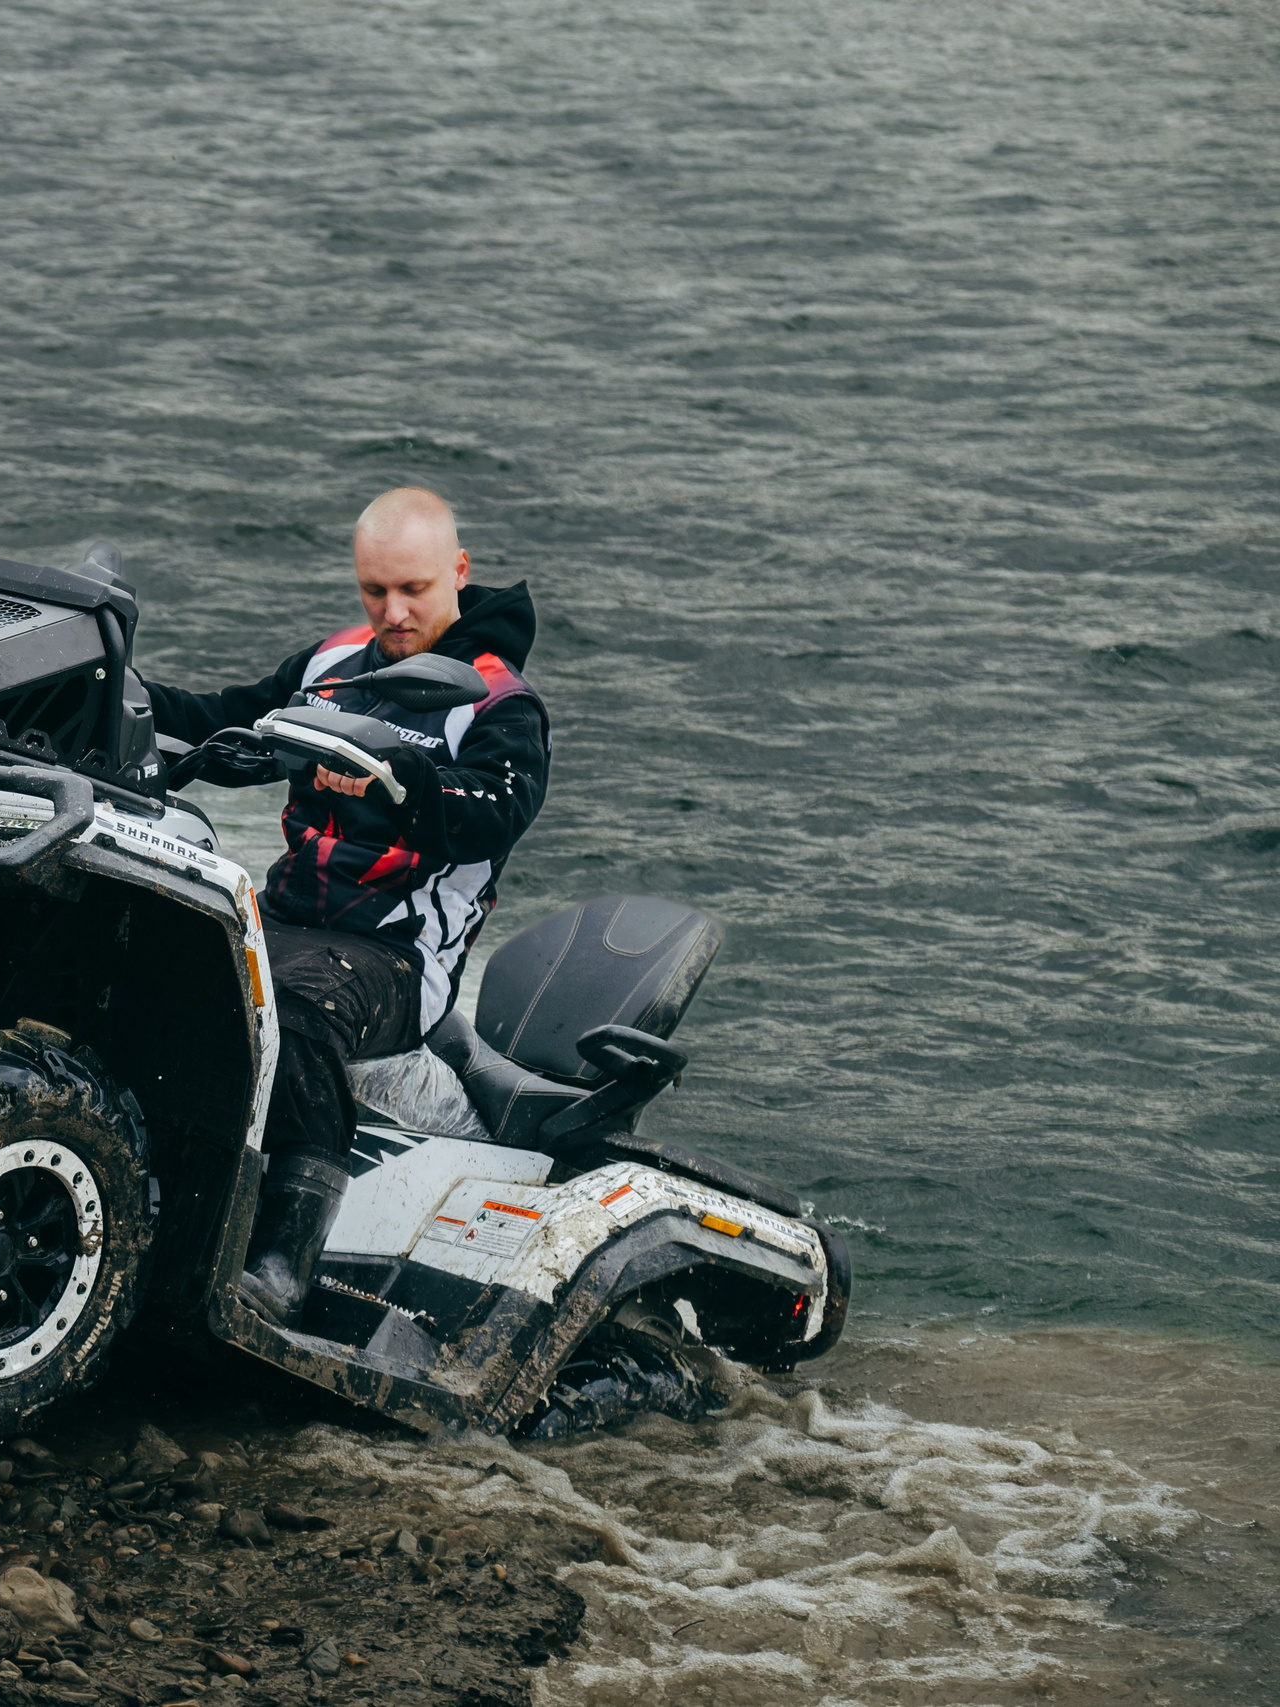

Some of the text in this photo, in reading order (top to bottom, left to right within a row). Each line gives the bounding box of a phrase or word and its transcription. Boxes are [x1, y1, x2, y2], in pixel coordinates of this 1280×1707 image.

[116, 821, 197, 860] SHARMAX
[742, 1210, 752, 1219] IN
[755, 1215, 793, 1236] MOTION
